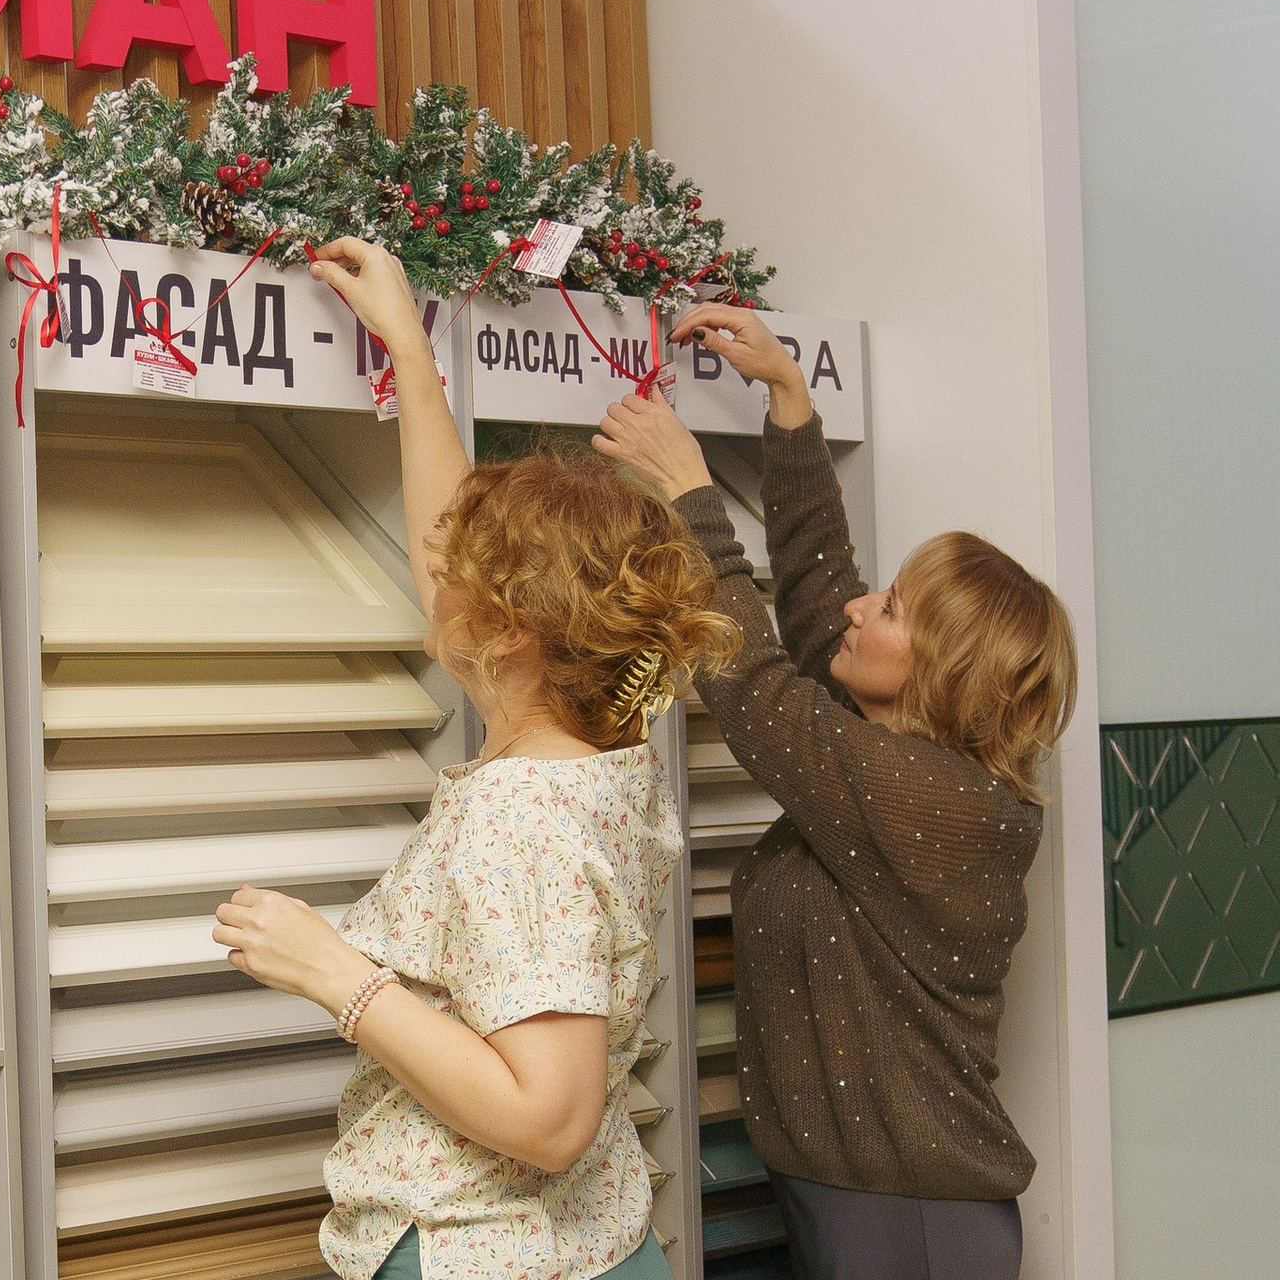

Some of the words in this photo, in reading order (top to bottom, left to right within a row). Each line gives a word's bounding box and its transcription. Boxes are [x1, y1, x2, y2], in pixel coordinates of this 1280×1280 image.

[48, 259, 294, 388] ФАСАД
[477, 324, 583, 384] ФАСАД
[610, 337, 648, 379] МК
